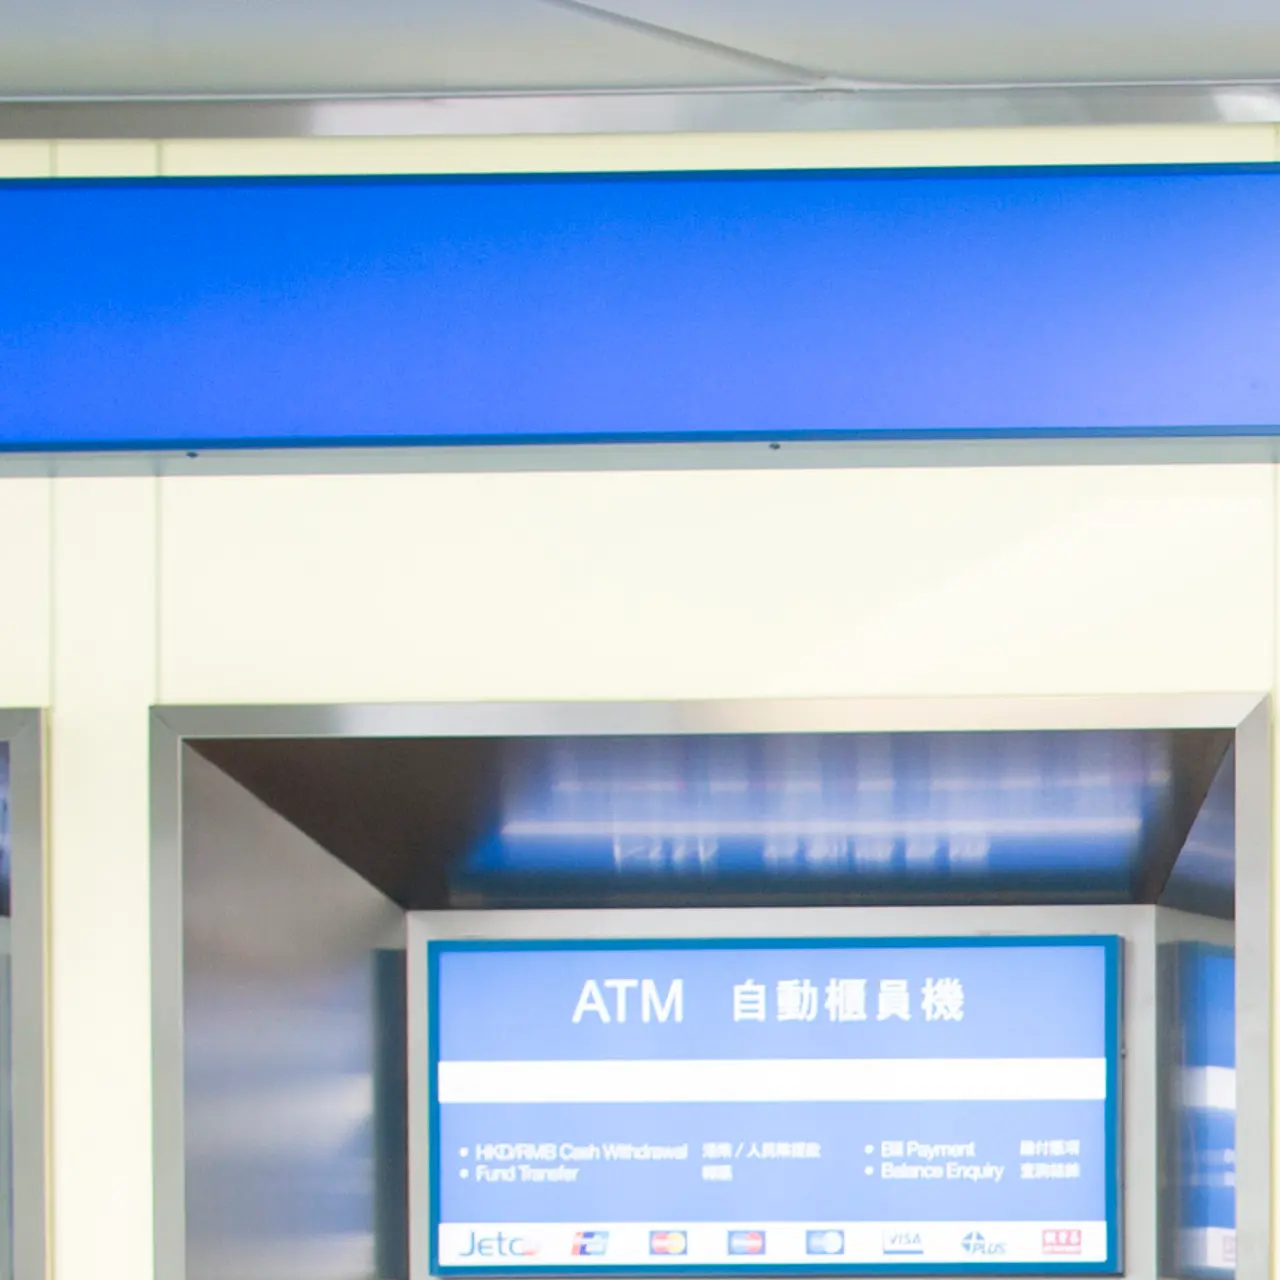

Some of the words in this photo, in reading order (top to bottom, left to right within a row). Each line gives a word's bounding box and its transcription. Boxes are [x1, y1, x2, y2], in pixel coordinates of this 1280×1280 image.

[571, 979, 685, 1023] ATM
[731, 978, 966, 1023] 自動櫃員機
[475, 1143, 557, 1161] HKD/RMB
[559, 1143, 601, 1160] Cash
[602, 1143, 689, 1161] Withdrawal
[880, 1140, 904, 1157] Bill
[906, 1140, 976, 1161] Payment
[475, 1164, 516, 1182] Fund
[520, 1164, 580, 1182] Transfer
[880, 1162, 944, 1179] Balance
[946, 1162, 1005, 1182] Enquiry
[889, 1233, 922, 1246] VISA
[971, 1241, 1007, 1254] PLUS
